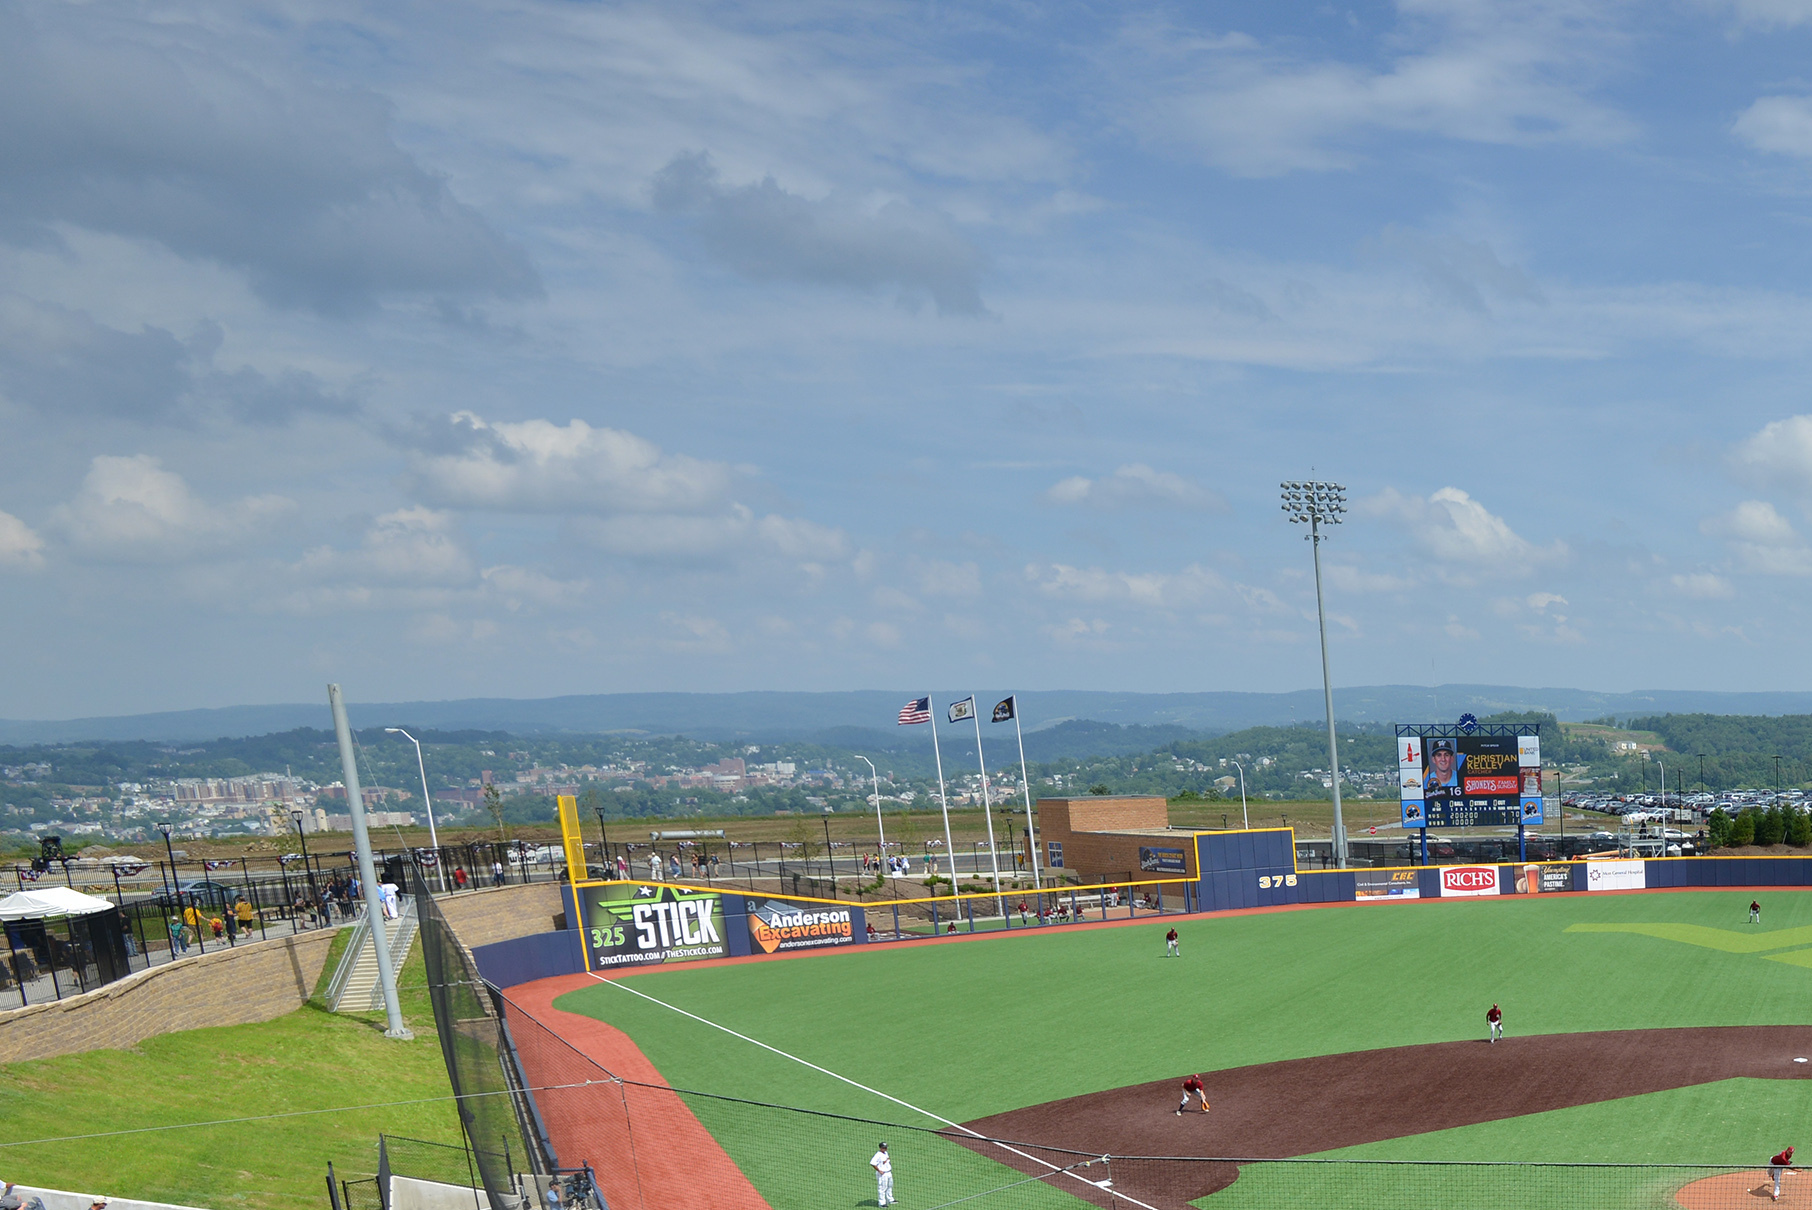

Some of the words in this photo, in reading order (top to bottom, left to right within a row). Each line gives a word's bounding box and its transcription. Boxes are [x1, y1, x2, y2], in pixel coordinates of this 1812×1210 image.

[1466, 754, 1517, 763] CHRISTIAN
[1449, 787, 1462, 796] 16
[1258, 873, 1298, 889] 375
[1446, 870, 1495, 888] RICH'S
[1542, 873, 1568, 881] AMERICA'S
[747, 900, 757, 911] a
[770, 910, 850, 929] Anderson
[591, 927, 626, 948] 325
[760, 921, 853, 941] Excavating
[779, 936, 853, 949] andersonexcavating.com
[600, 952, 661, 966] STICKTATTOO.COM
[666, 945, 723, 959] THESTICKCO.COM
